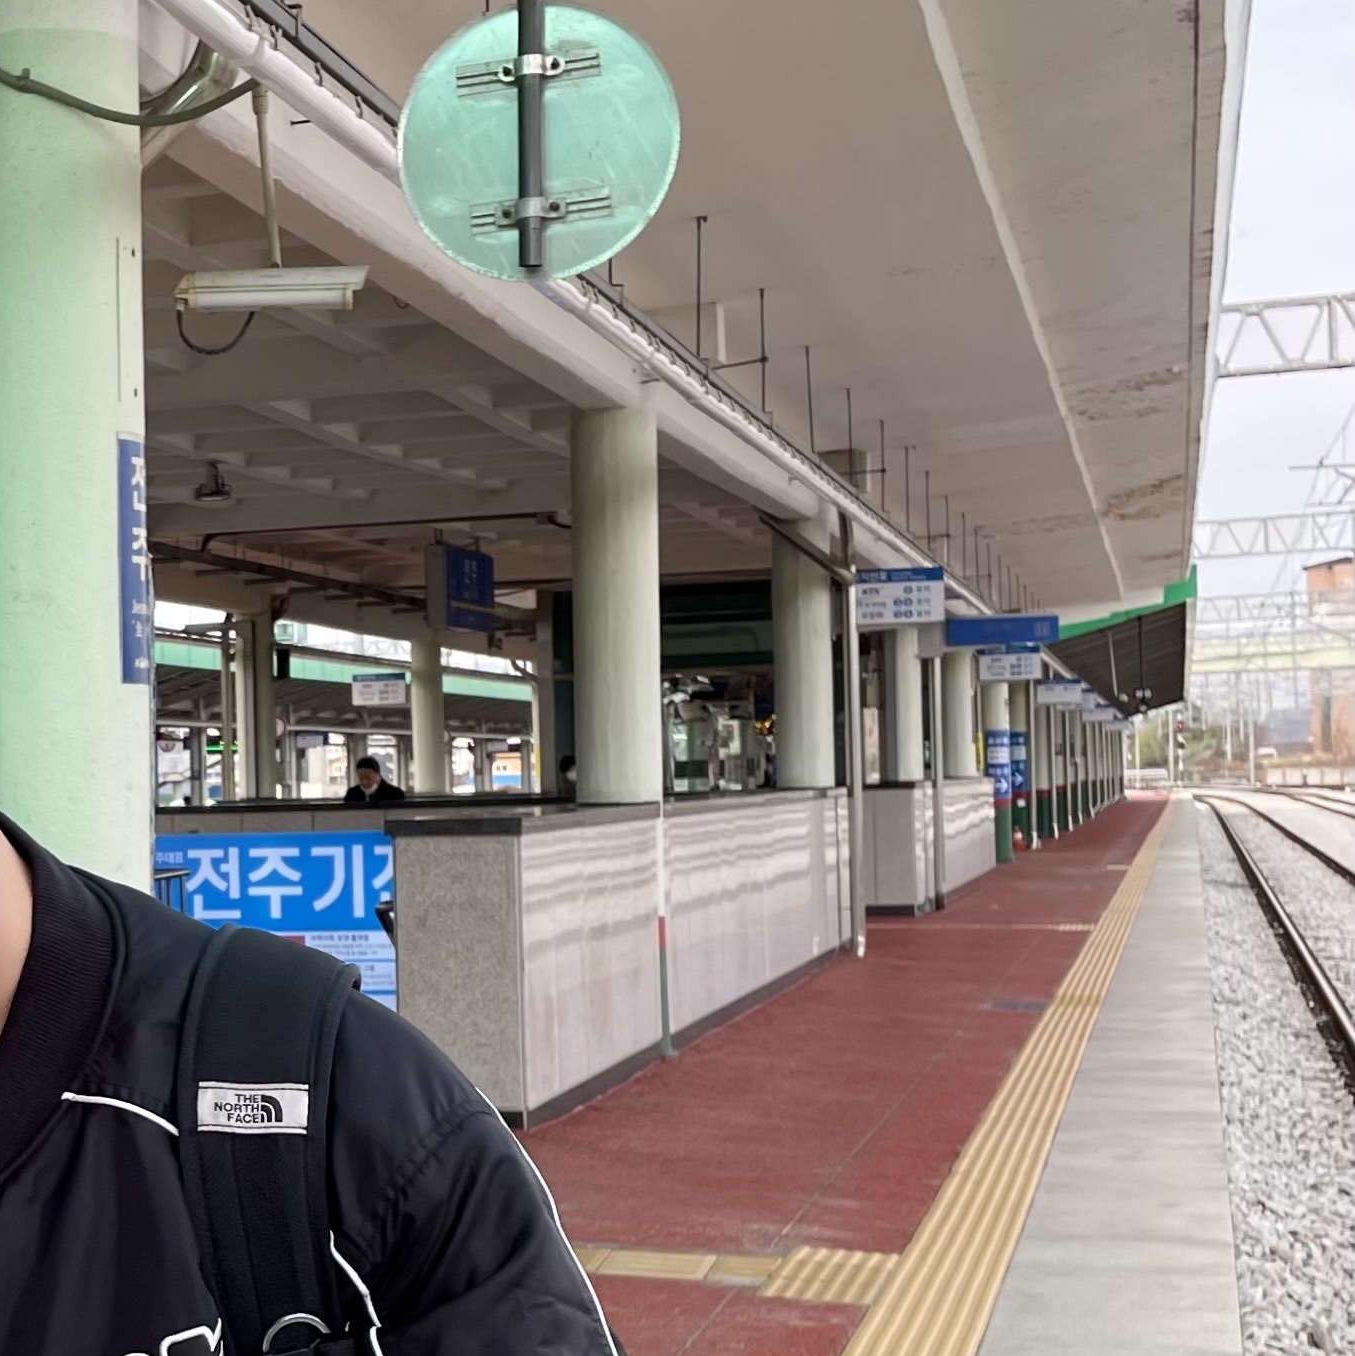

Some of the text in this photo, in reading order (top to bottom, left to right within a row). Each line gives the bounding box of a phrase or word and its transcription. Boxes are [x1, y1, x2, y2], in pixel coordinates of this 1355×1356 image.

[235, 1093, 261, 1104] THE
[213, 1101, 261, 1114] NORTH
[226, 1112, 261, 1124] FACE
